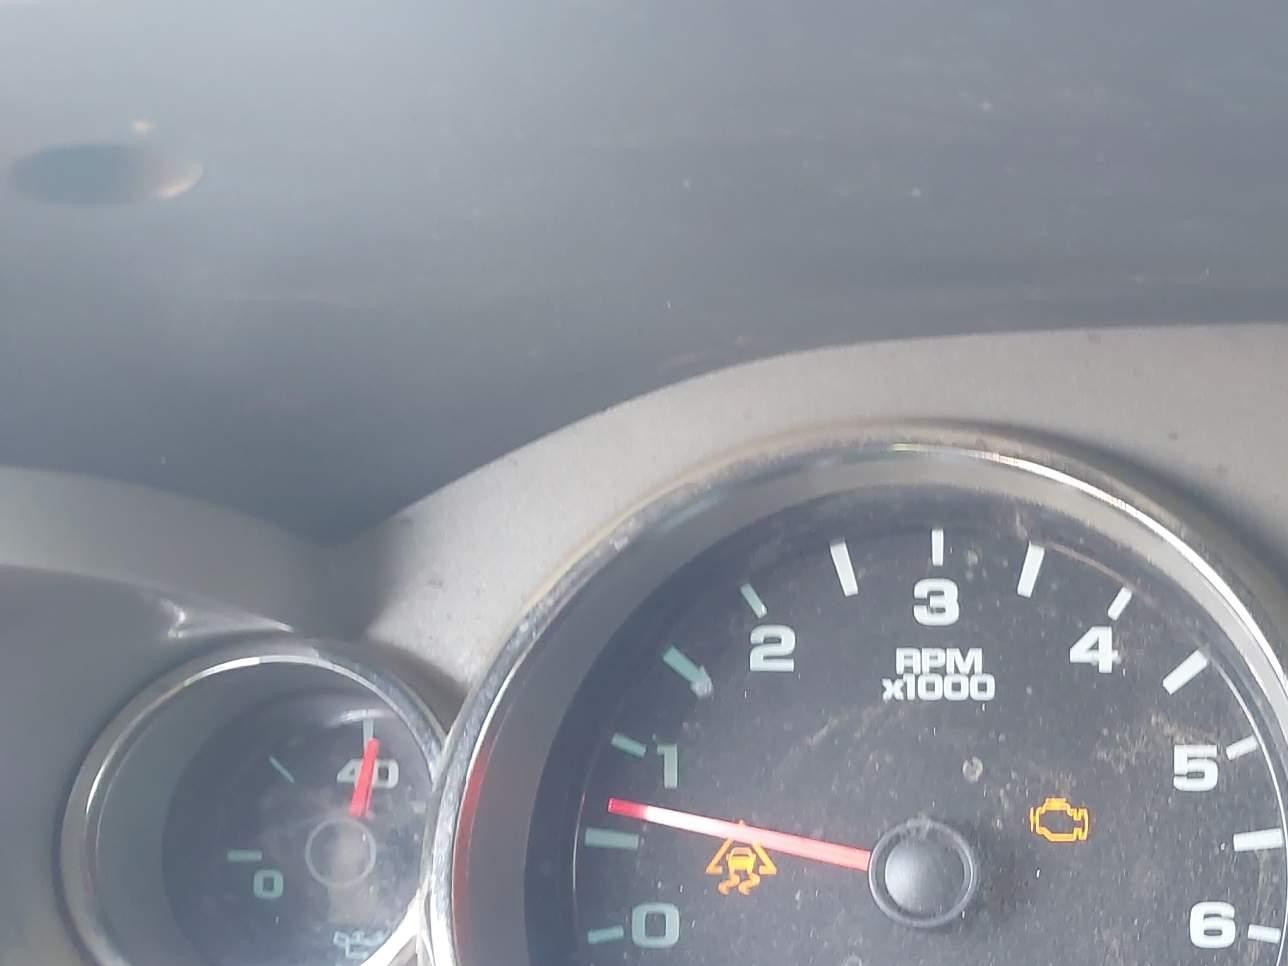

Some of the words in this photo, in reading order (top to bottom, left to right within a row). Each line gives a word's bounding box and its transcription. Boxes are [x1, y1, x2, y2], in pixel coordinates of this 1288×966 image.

[913, 578, 959, 626] 3
[749, 625, 796, 672] 2
[895, 647, 983, 676] RPM
[1070, 627, 1119, 673] 4
[881, 672, 996, 701] x1000
[655, 744, 679, 789] 1
[1173, 744, 1219, 792] 5
[253, 870, 284, 900] 0
[631, 902, 681, 949] 0
[1188, 901, 1237, 949] 6
